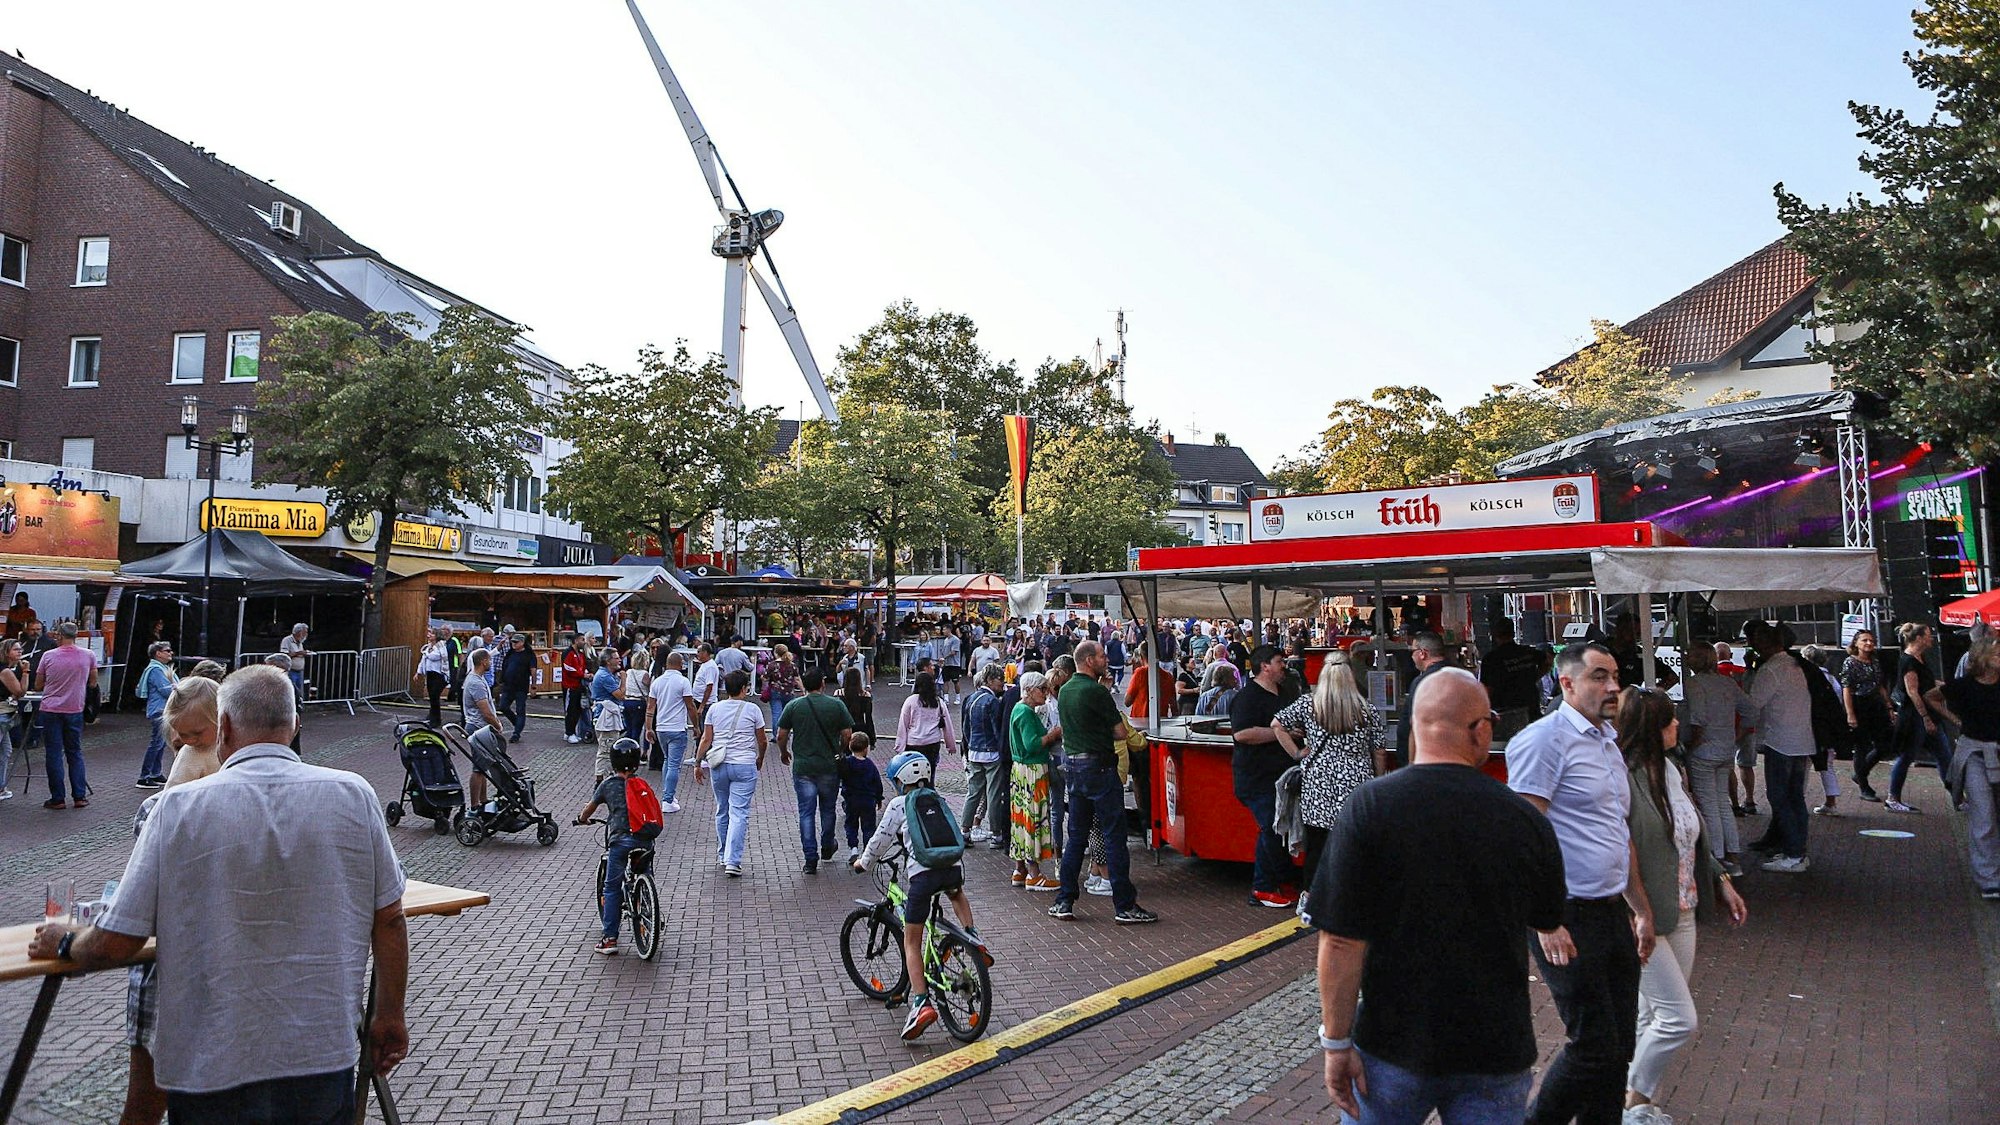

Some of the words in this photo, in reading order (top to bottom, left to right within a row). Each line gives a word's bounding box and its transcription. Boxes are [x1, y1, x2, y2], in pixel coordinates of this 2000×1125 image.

[48, 470, 82, 491] dm
[1470, 498, 1523, 511] KÖLSCH
[1907, 485, 1961, 504] GENOSSEN
[212, 505, 280, 530] Mamma
[285, 508, 317, 531] Mia
[229, 505, 260, 513] Pizzeria
[1307, 510, 1354, 521] KÖLSCH
[1377, 493, 1441, 528] früh
[1908, 499, 1962, 521] SCHAFT
[25, 515, 43, 528] BAR
[423, 526, 437, 547] Mia
[563, 545, 595, 566] JULIA
